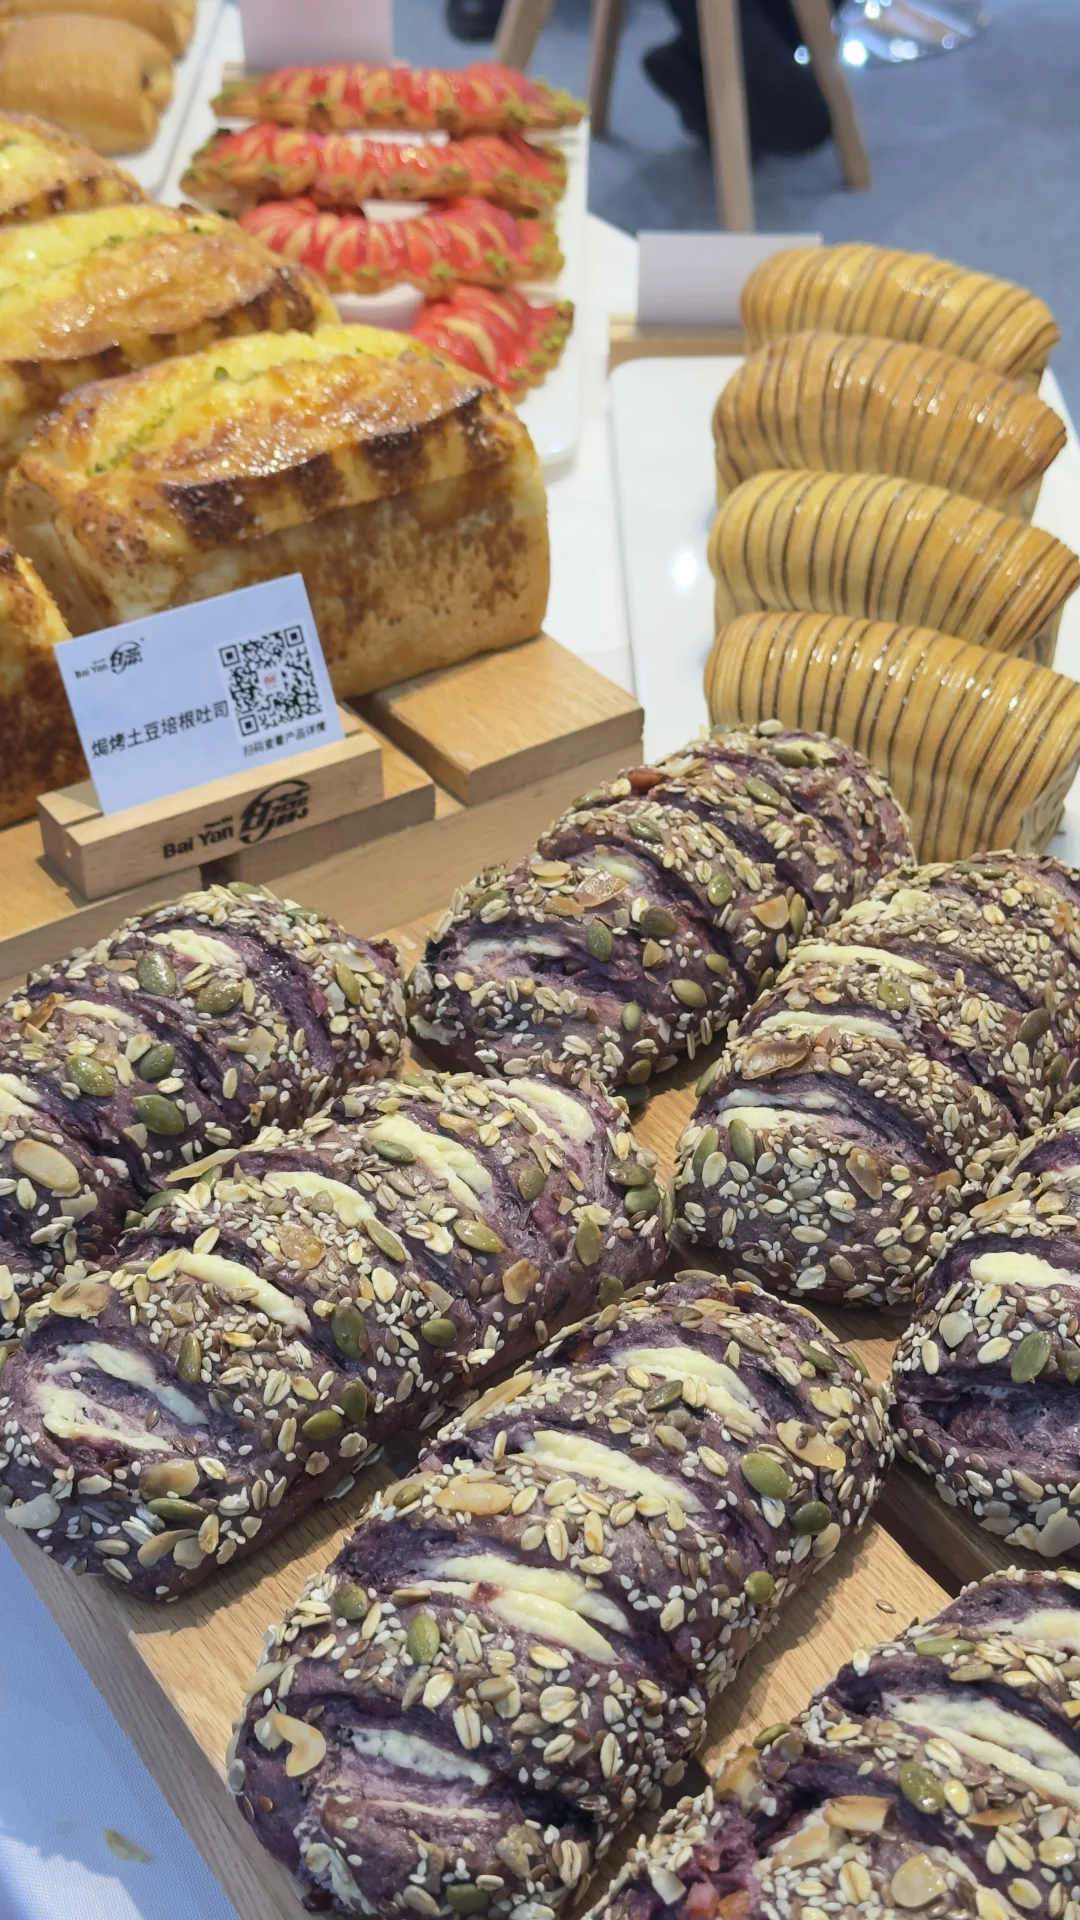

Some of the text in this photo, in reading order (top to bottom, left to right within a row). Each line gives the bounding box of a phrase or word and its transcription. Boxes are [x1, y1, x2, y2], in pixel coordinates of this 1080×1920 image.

[91, 700, 230, 759] 焗烤土豆培根吐司
[163, 826, 234, 860] Bai Yan
